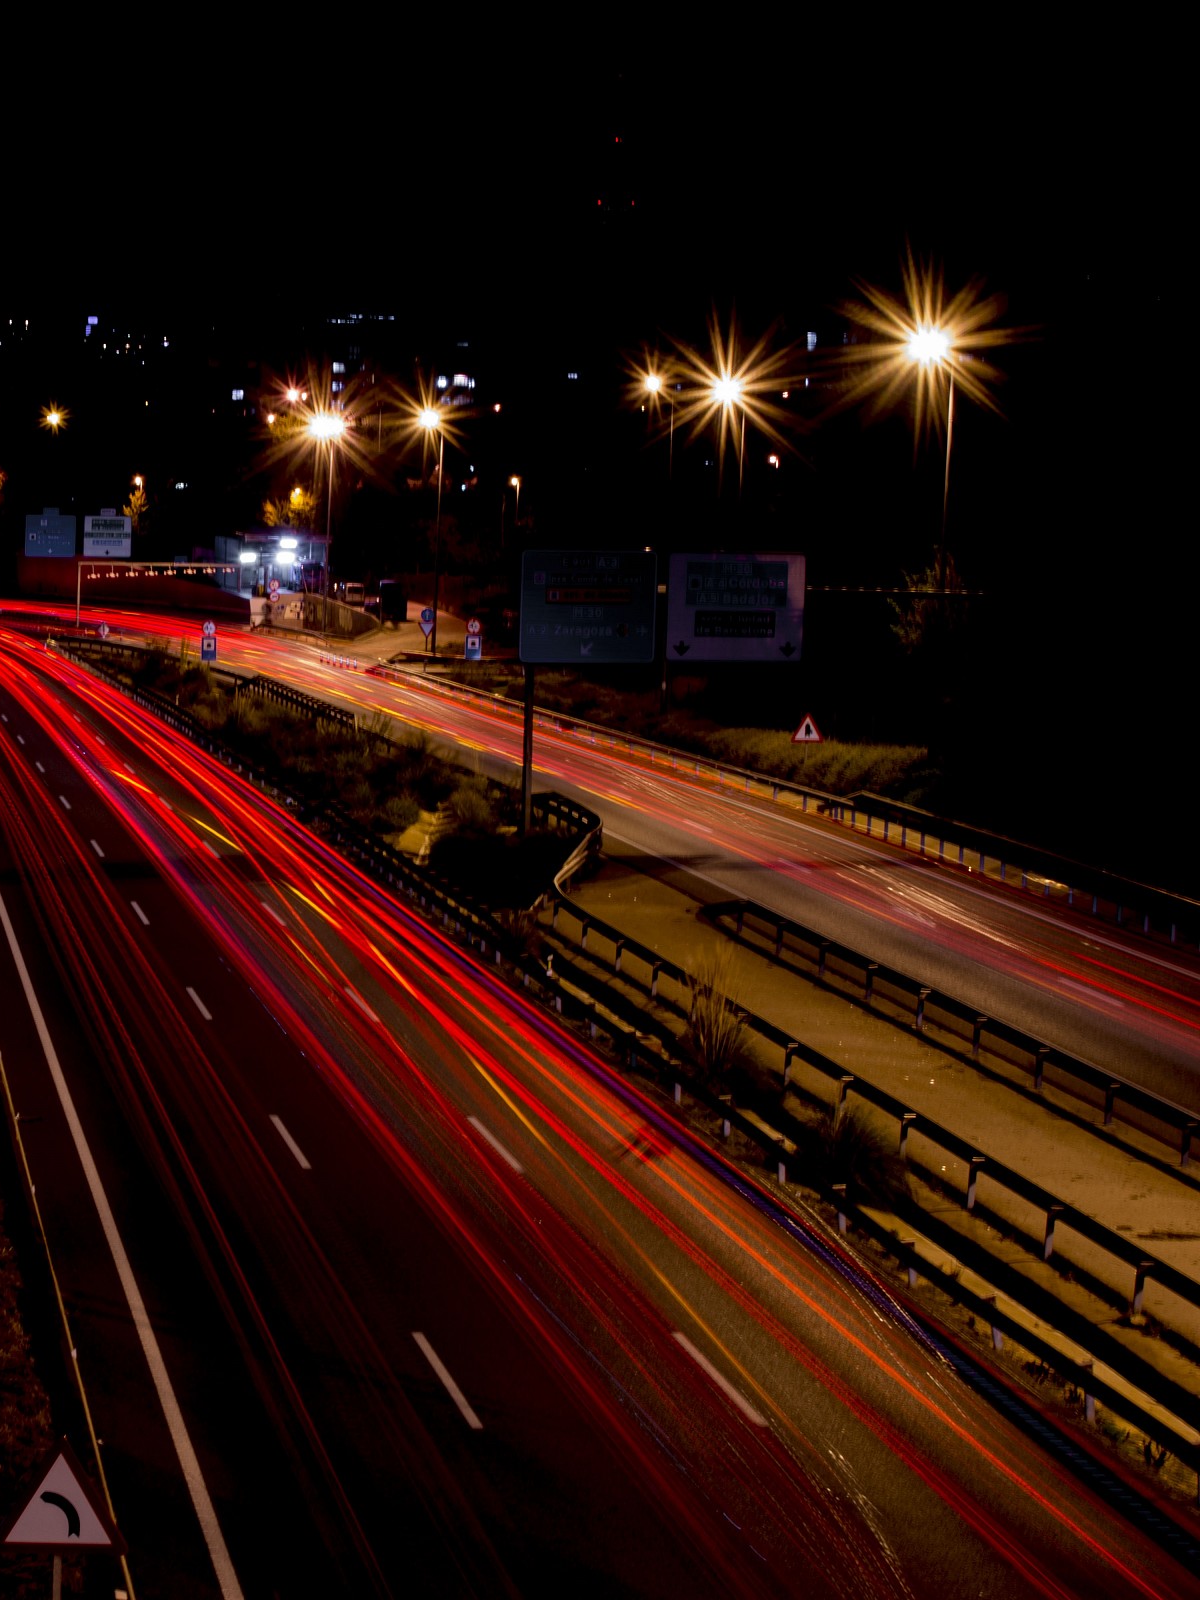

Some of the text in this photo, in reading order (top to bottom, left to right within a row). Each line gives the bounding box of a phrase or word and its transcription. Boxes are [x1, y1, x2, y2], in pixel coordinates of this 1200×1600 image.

[722, 592, 776, 606] Badajoz
[574, 606, 603, 616] M-30
[554, 622, 613, 634] Zaragoza
[696, 625, 773, 634] de Barcelona
